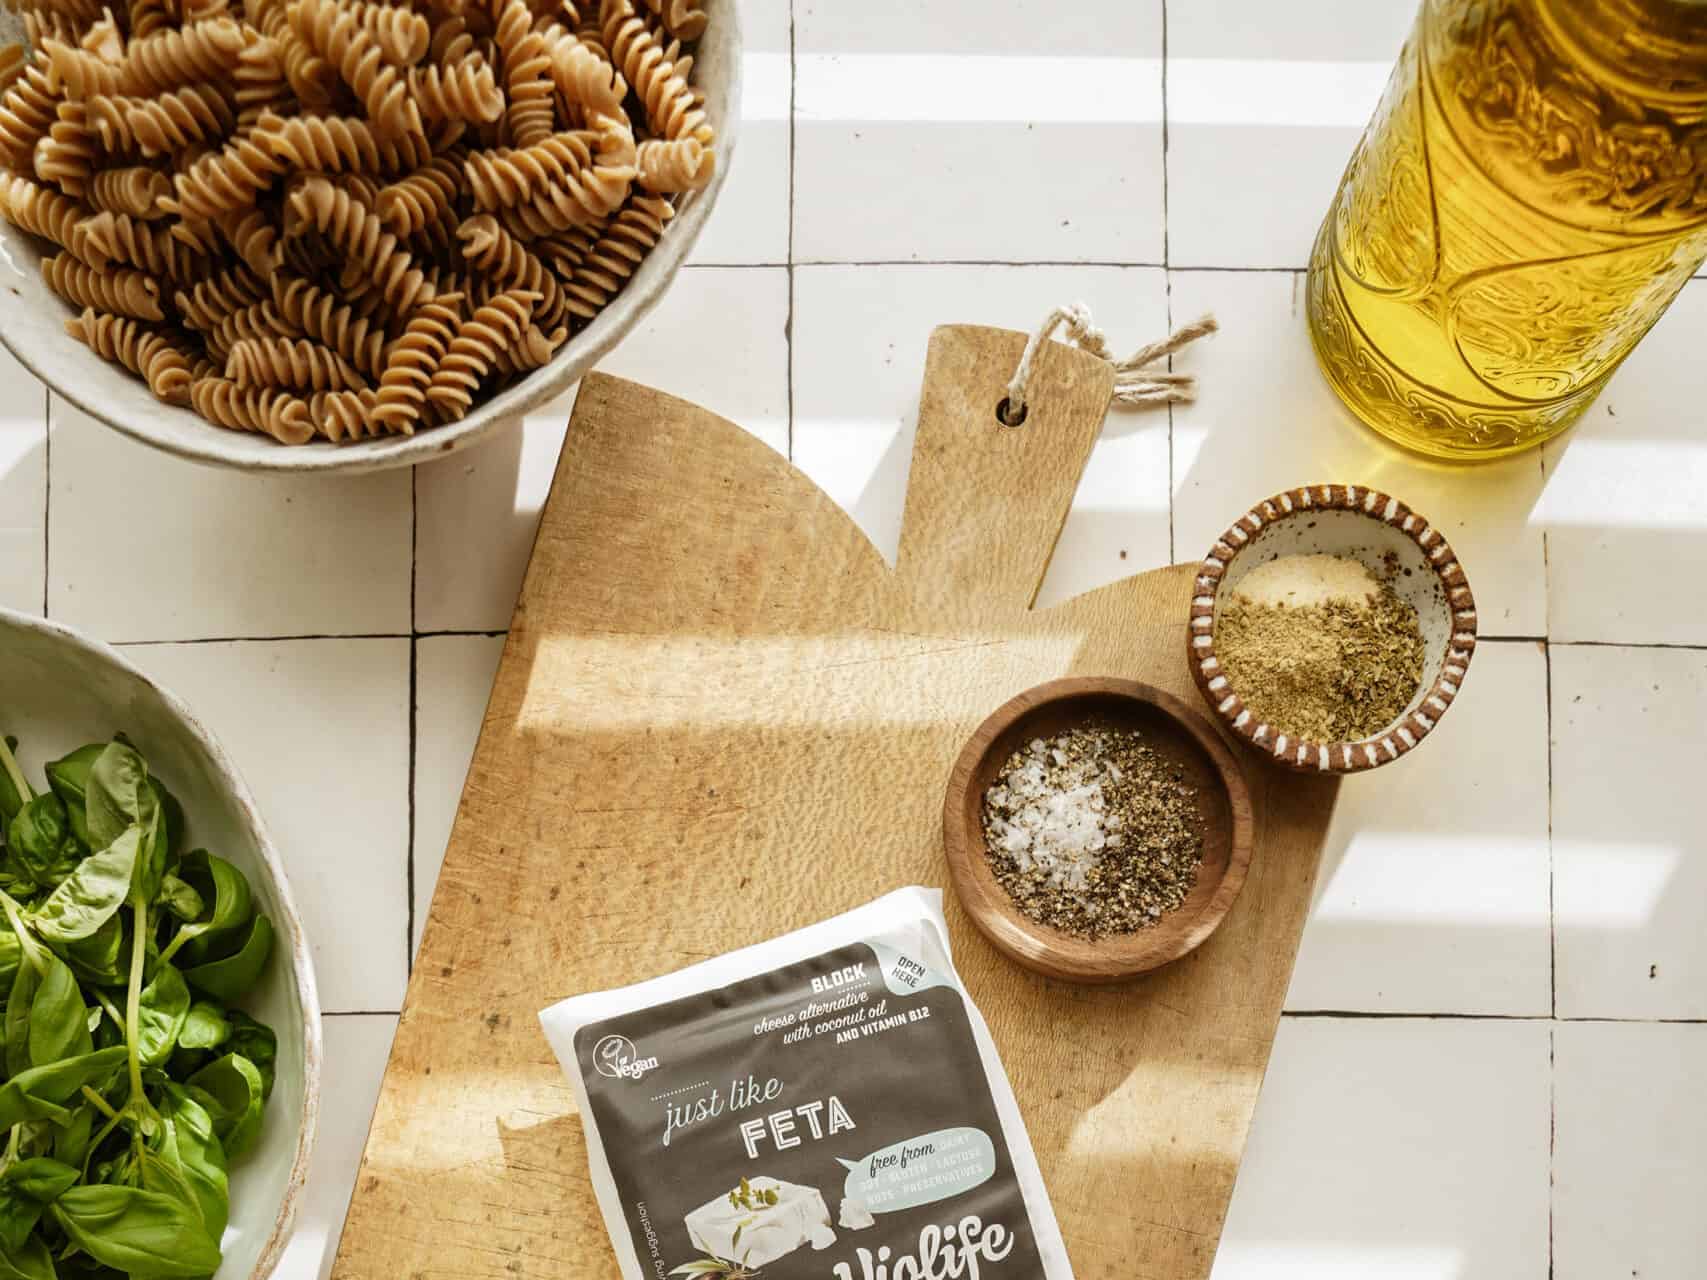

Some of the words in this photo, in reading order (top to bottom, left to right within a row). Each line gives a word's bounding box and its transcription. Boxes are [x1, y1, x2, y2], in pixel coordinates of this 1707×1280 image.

[811, 962, 867, 994] BLOCK
[892, 967, 919, 988] HERE
[898, 956, 926, 977] OPEN
[753, 1013, 797, 1035] cheese
[799, 991, 869, 1022] alternative
[783, 1026, 812, 1045] with
[815, 1009, 866, 1035] coconut
[868, 999, 888, 1018] oil
[836, 1028, 860, 1045] AND
[861, 1013, 907, 1037] VITAMIN
[908, 1006, 930, 1022] B12
[662, 1089, 725, 1146] just
[730, 1075, 784, 1111] like
[739, 1095, 856, 1159] FETA
[870, 1155, 898, 1178] free
[900, 1143, 935, 1168] from
[637, 1201, 660, 1258] suggestion
